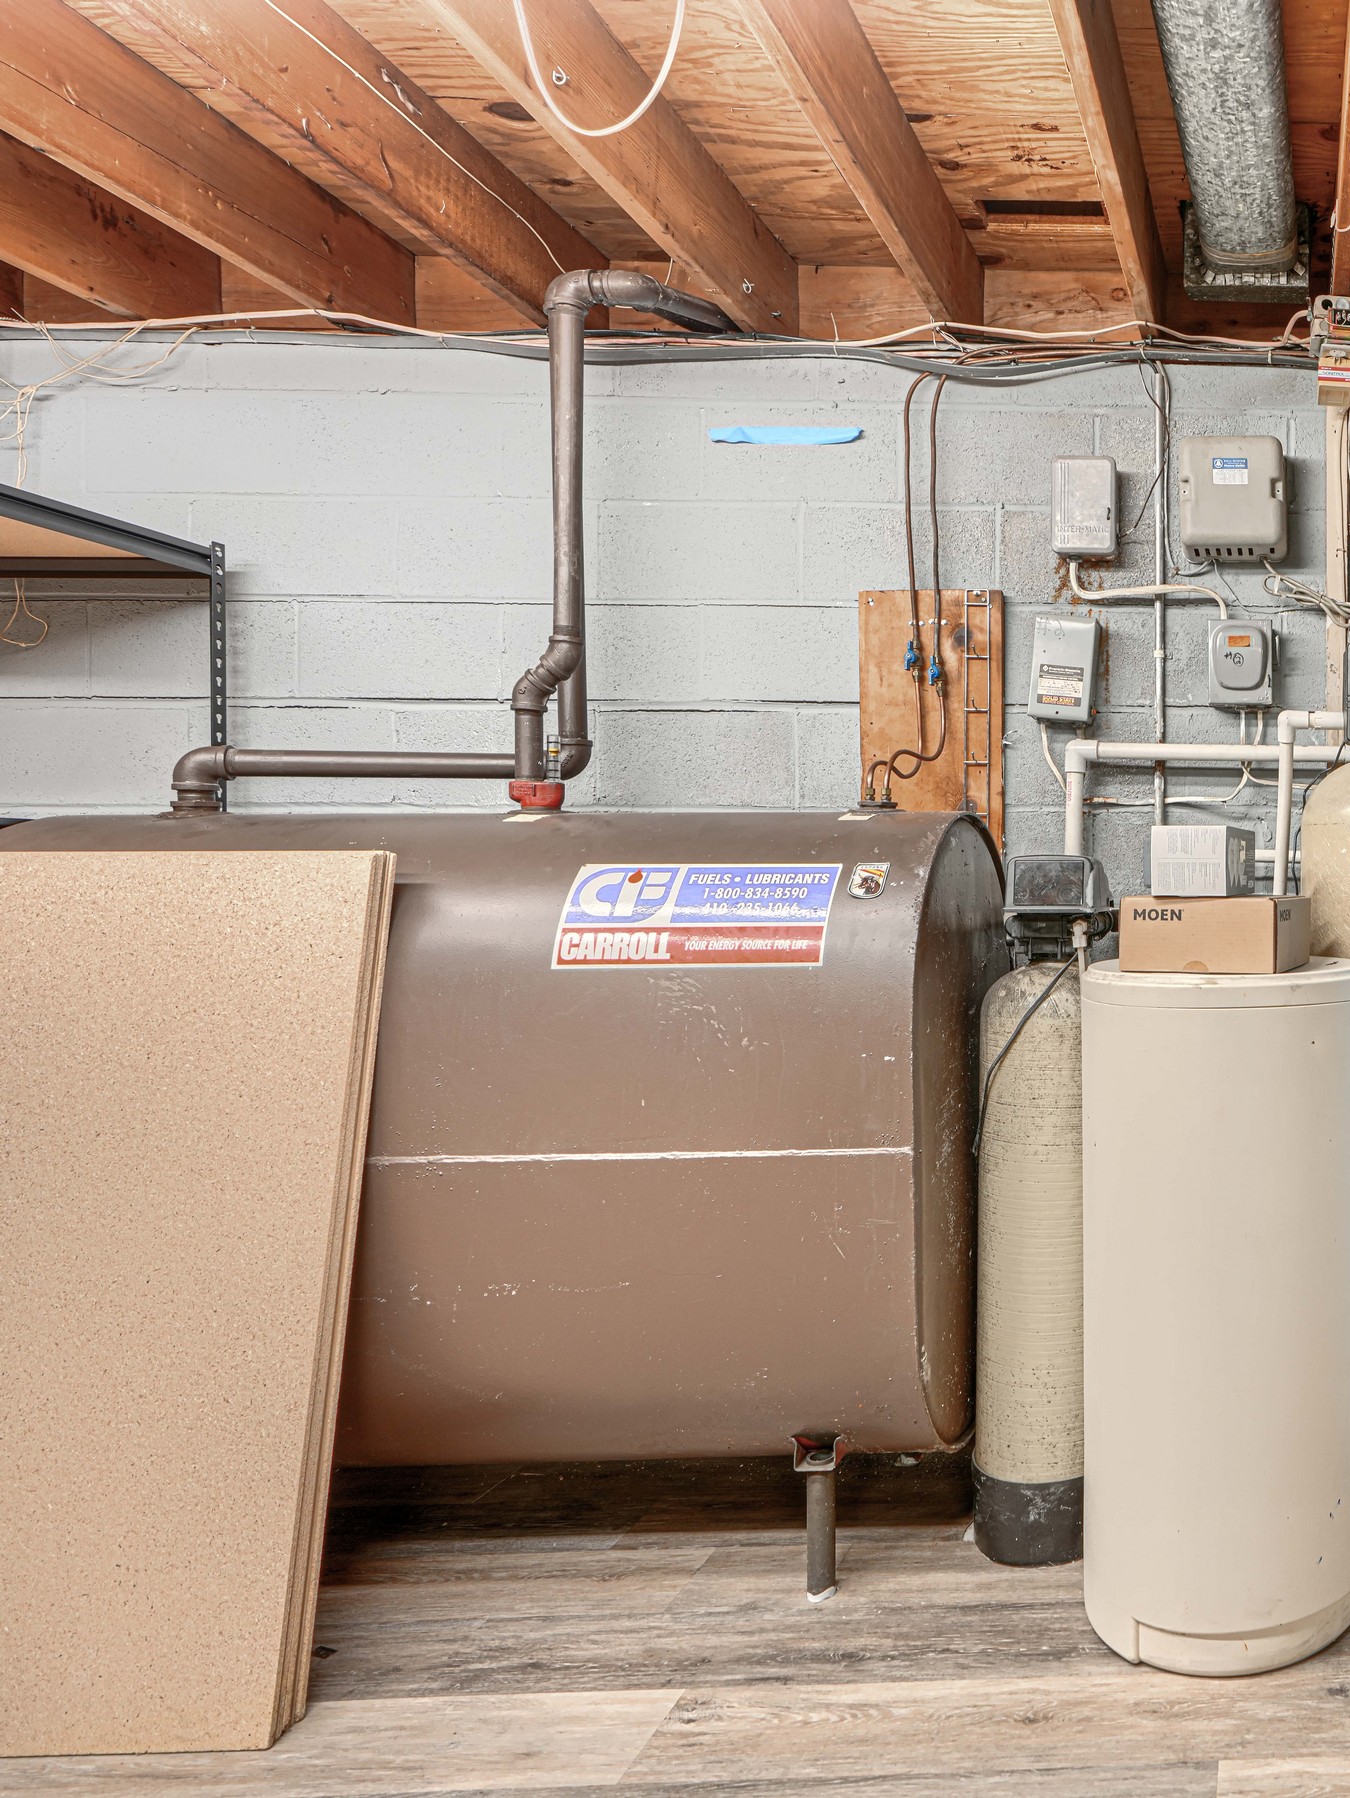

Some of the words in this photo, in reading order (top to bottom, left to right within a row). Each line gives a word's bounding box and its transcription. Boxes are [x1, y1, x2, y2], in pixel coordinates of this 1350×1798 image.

[688, 873, 732, 884] FUELS
[745, 873, 831, 884] LUBRICANTS
[703, 887, 807, 899] 1-800-834-8590
[1133, 908, 1184, 922] MOEN
[1279, 908, 1292, 922] MOEN
[560, 931, 671, 961] CARROLL
[684, 939, 706, 951] YOUR
[708, 939, 740, 950] ENERGY
[741, 939, 773, 950] SOURCE
[774, 939, 790, 950] FOR
[792, 939, 809, 950] LIFE
